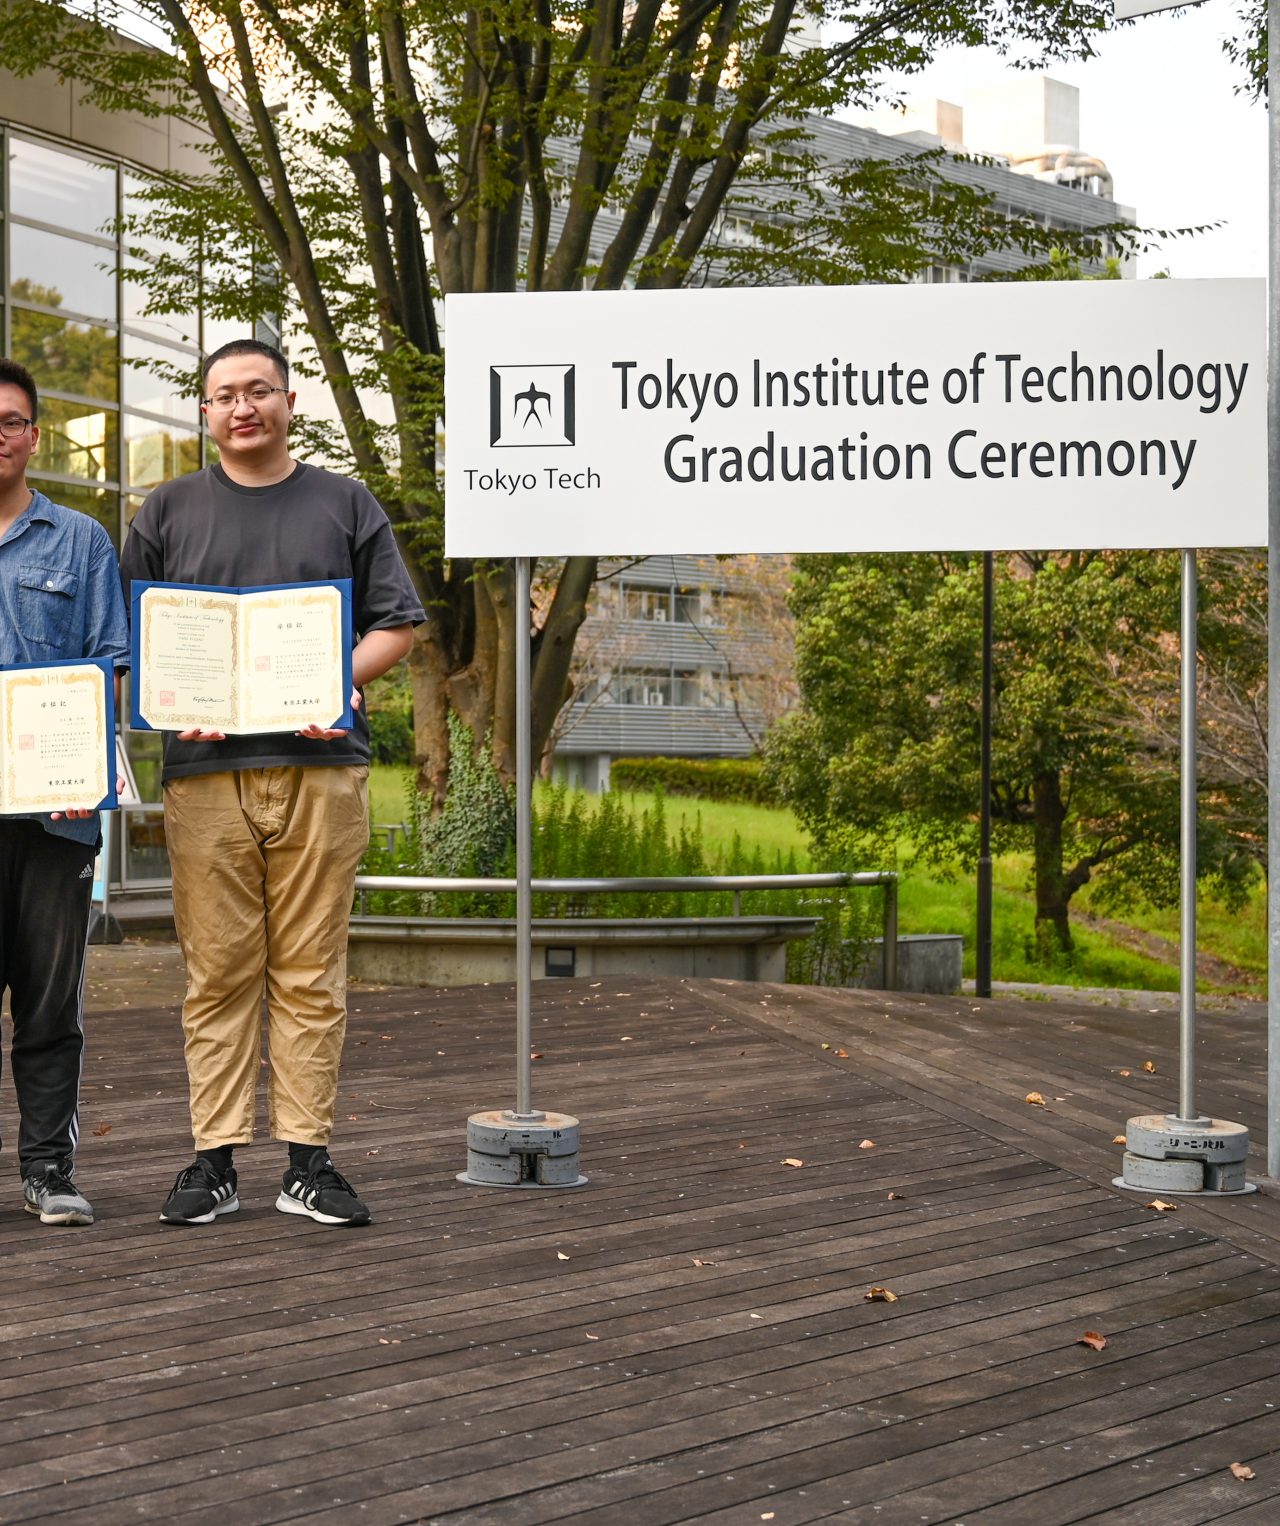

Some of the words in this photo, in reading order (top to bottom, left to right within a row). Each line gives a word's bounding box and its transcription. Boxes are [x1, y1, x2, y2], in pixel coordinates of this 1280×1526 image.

[611, 358, 739, 424] Tokyo
[753, 357, 929, 408] Institute
[942, 351, 987, 405] of
[995, 348, 1249, 415] Technology
[463, 468, 537, 496] Tokyo
[543, 466, 601, 490] Tech
[663, 430, 931, 484] Graduation
[947, 429, 1198, 491] Ceremony
